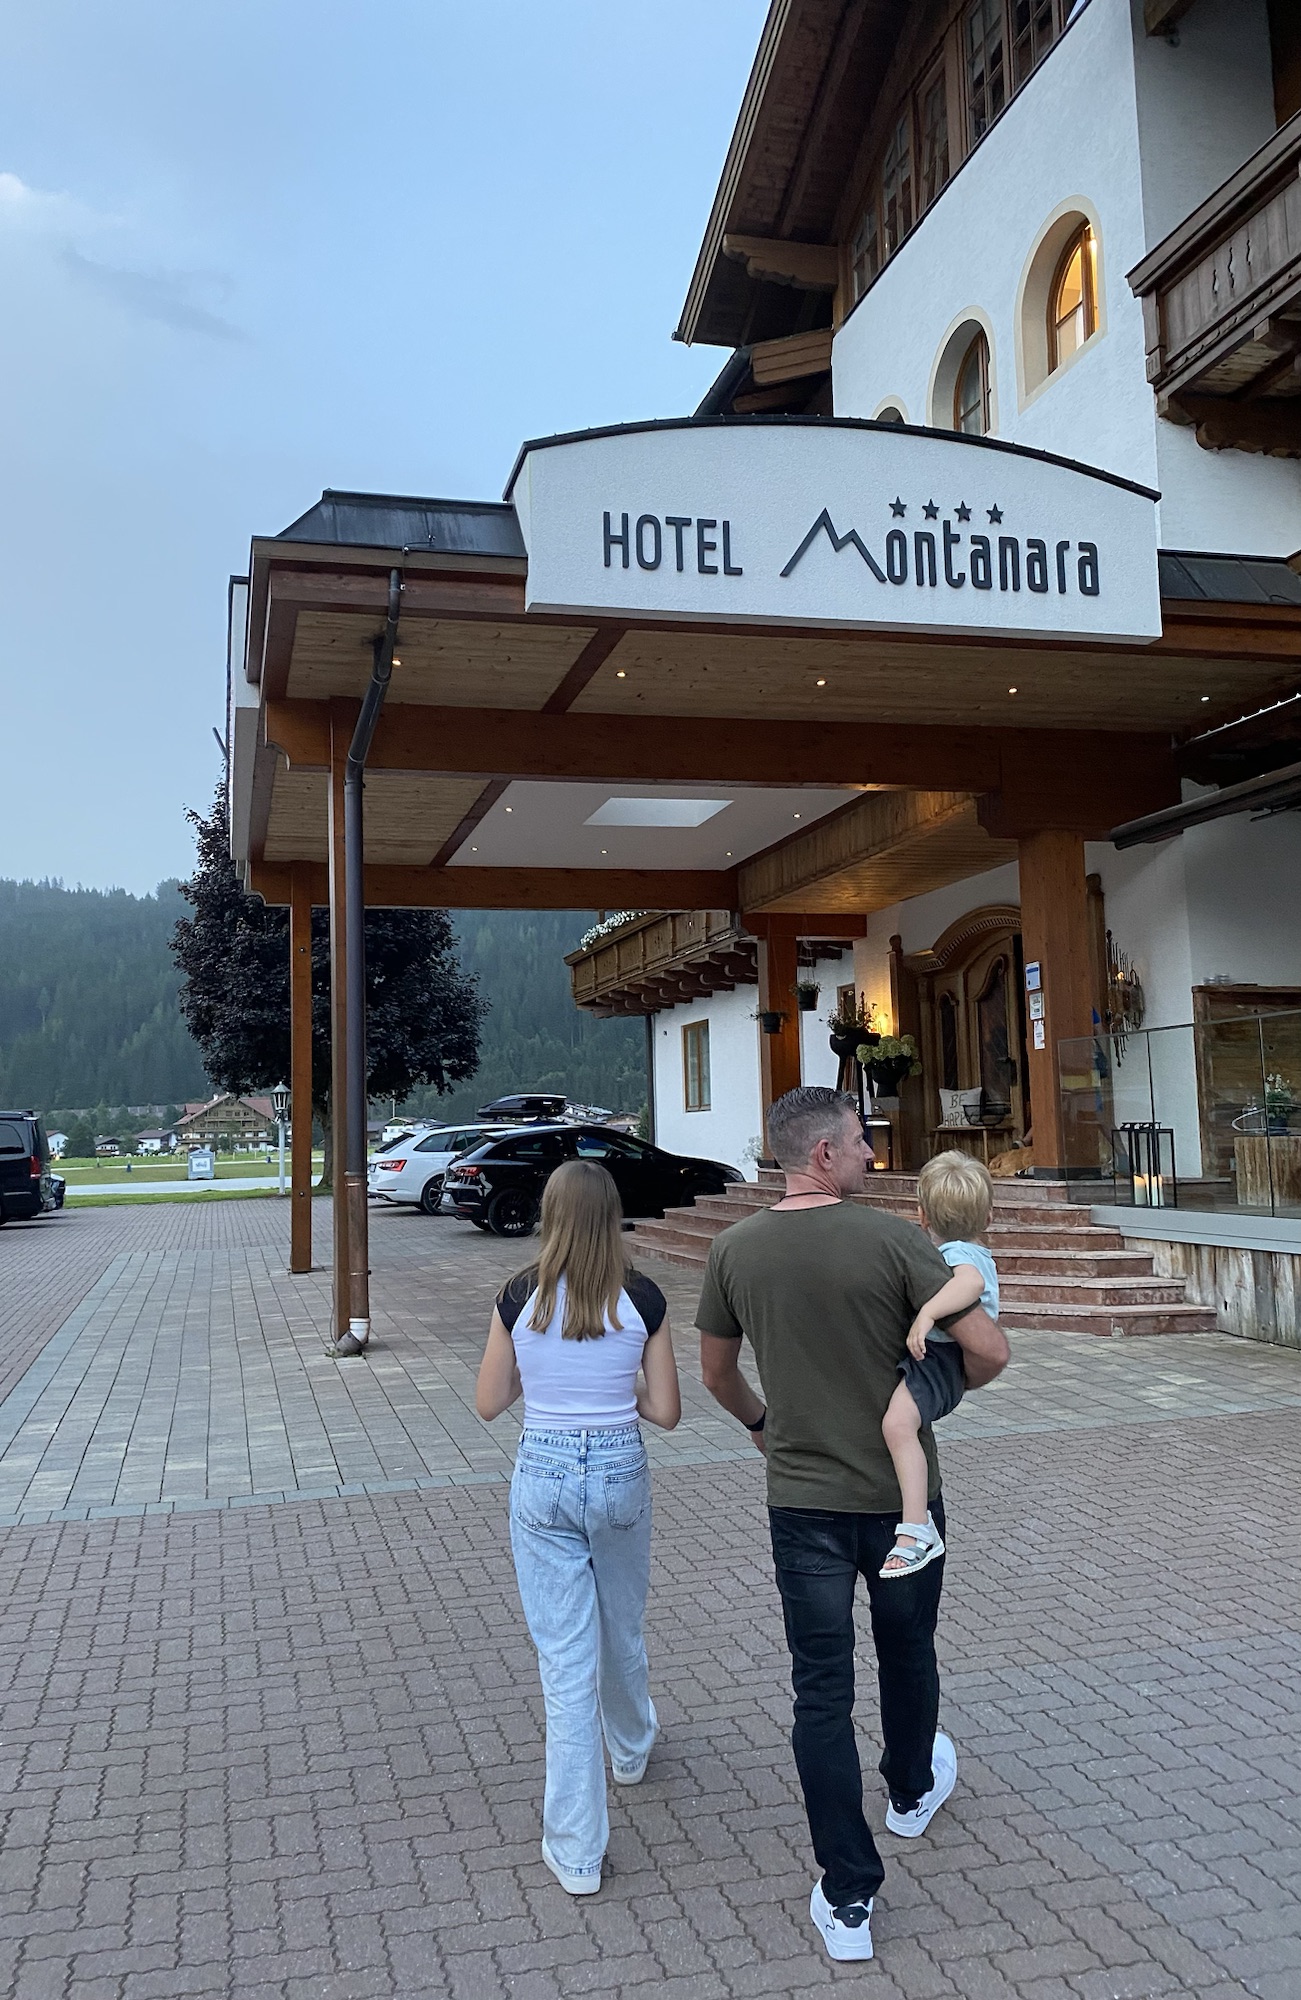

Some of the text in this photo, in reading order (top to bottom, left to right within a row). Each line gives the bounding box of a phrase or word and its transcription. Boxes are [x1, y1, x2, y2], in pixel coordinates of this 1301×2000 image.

[603, 507, 1100, 597] HOTEL Montanara
[949, 1093, 968, 1108] BE
